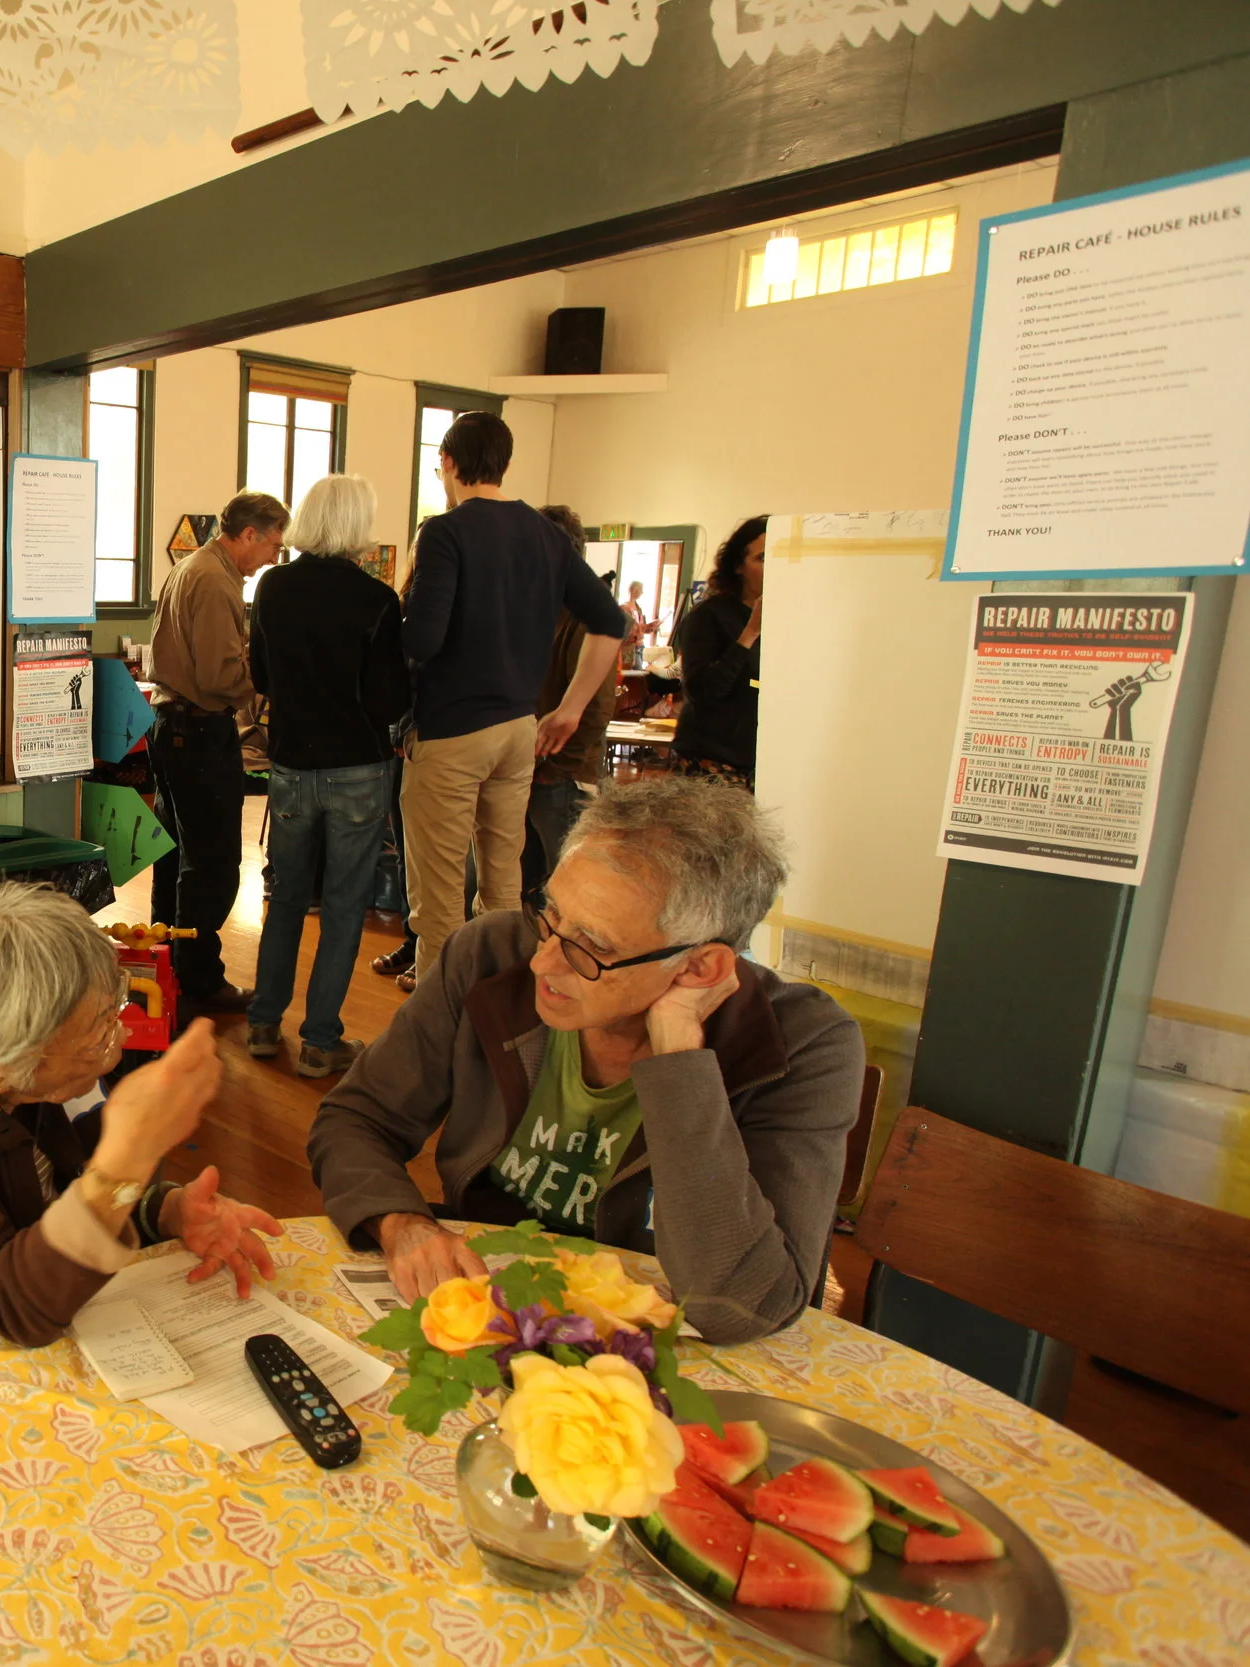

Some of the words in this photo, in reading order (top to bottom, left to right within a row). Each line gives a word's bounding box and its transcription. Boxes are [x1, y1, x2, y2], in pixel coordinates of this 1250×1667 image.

[1018, 242, 1070, 261] REPAIR
[1075, 230, 1112, 250] CAFÉ
[1127, 218, 1183, 240] HOUSE
[1188, 205, 1241, 227] RULES
[1016, 272, 1050, 285] Please
[1053, 268, 1070, 278] DO
[1027, 292, 1038, 300] DO
[1022, 330, 1033, 338] DO
[998, 433, 1030, 442] Please
[1033, 427, 1068, 439] DON'T
[987, 528, 1022, 537] THANK
[1025, 526, 1052, 535] YOU!
[983, 607, 1051, 628] REPAIR
[1055, 607, 1176, 631] MANIFESTO
[16, 639, 44, 653] REPAIR
[46, 637, 87, 651] MANIFESTO
[20, 740, 54, 752] EVERYTHING
[973, 732, 1028, 748] CONNECTS
[1036, 745, 1088, 761] ENTROPY
[1099, 743, 1135, 757] REPAIR
[1140, 747, 1150, 758] IS
[1098, 755, 1148, 768] SUSTAINABLE
[1056, 767, 1066, 776] TO
[1069, 768, 1099, 779] CHOOSE
[965, 776, 1049, 800] EVERYTHING
[1104, 777, 1146, 789] FASTENERS
[1056, 794, 1075, 804] ANY
[1087, 797, 1102, 807] ALL
[956, 812, 979, 823] REPAIR
[1104, 830, 1137, 840] INSPIRES
